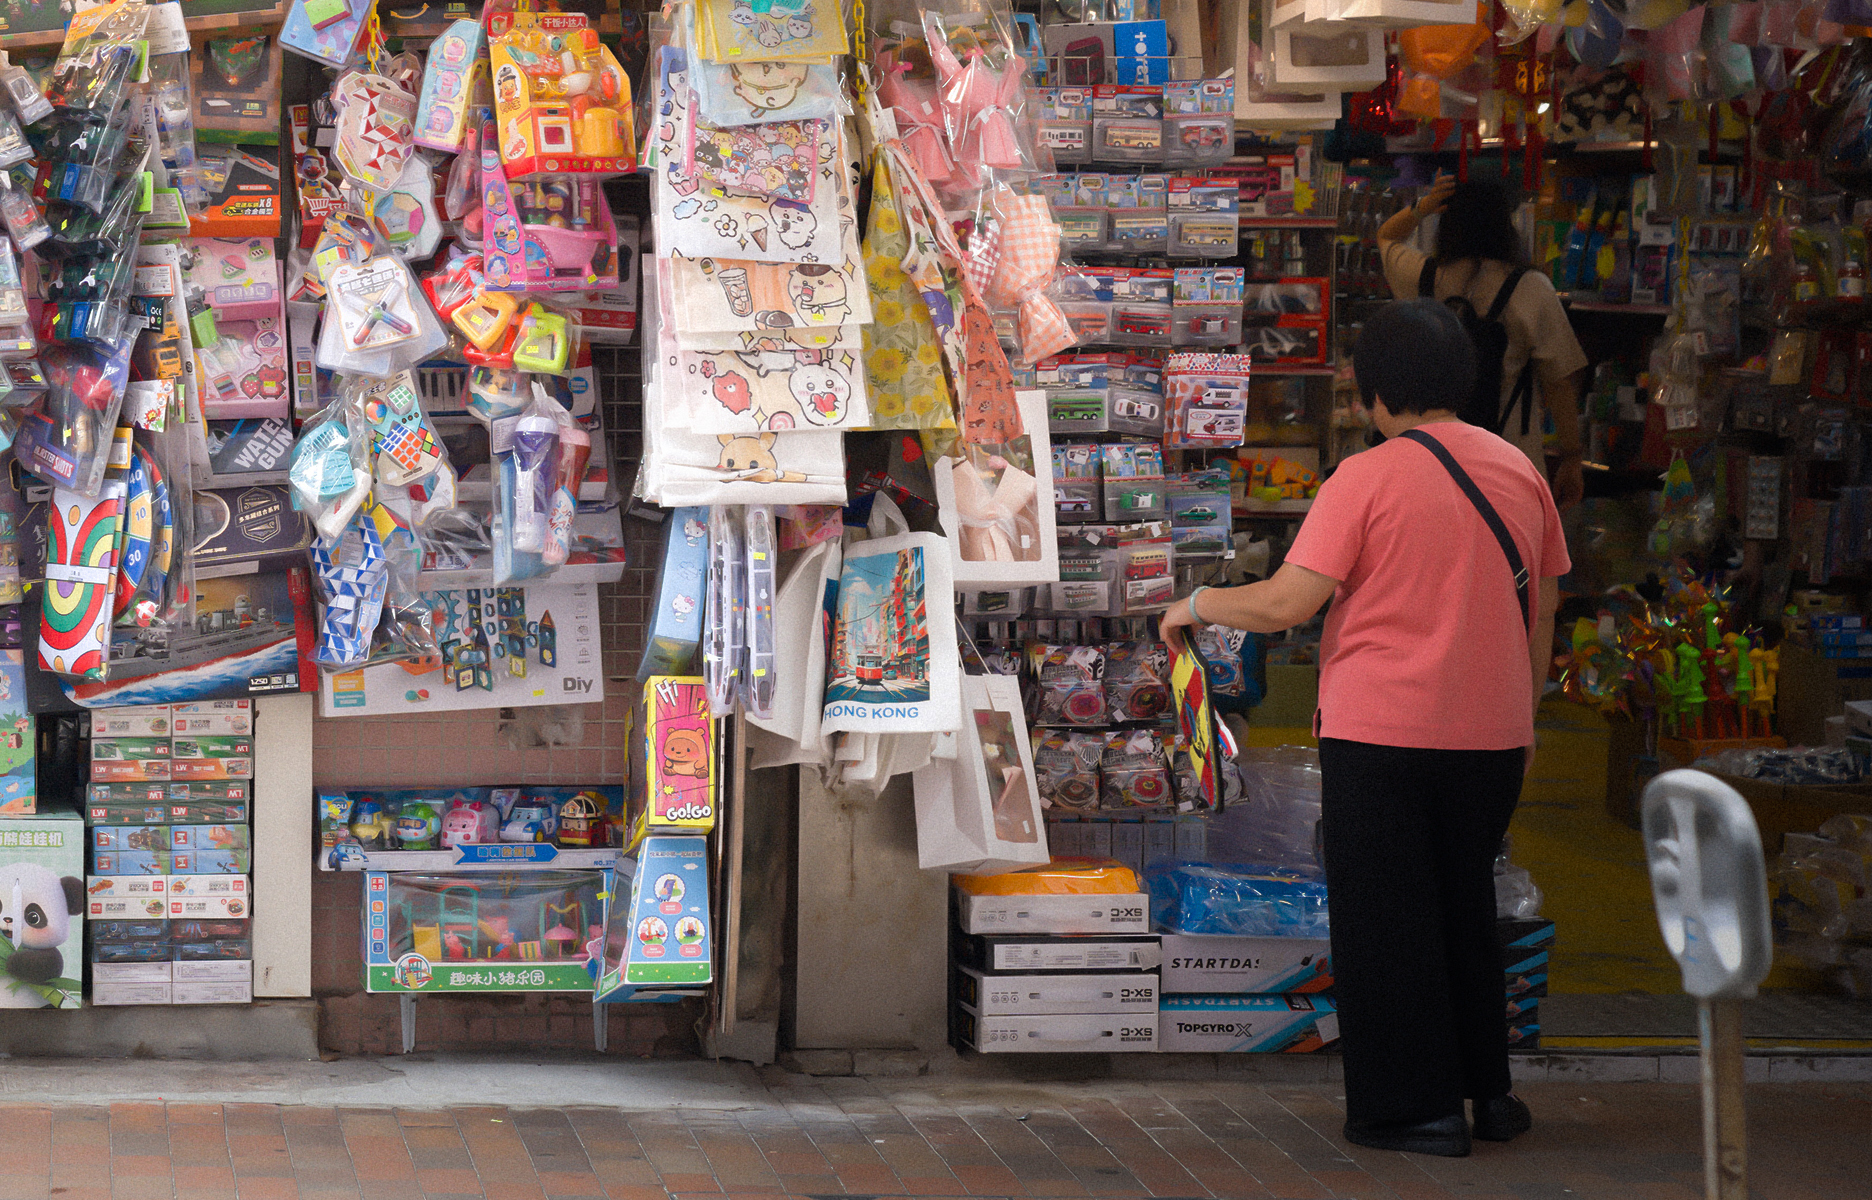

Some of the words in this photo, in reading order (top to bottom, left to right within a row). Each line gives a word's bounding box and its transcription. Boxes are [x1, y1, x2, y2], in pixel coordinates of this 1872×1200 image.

[257, 427, 293, 470] GUN
[135, 508, 147, 520] 10
[128, 550, 141, 564] 30
[563, 677, 593, 694] Diy
[654, 679, 679, 706] Hi
[824, 706, 868, 721] HONG
[872, 705, 919, 720] KONG
[92, 808, 107, 818] LW
[172, 806, 187, 816] LW
[450, 971, 545, 986] 趣味小猪乐园
